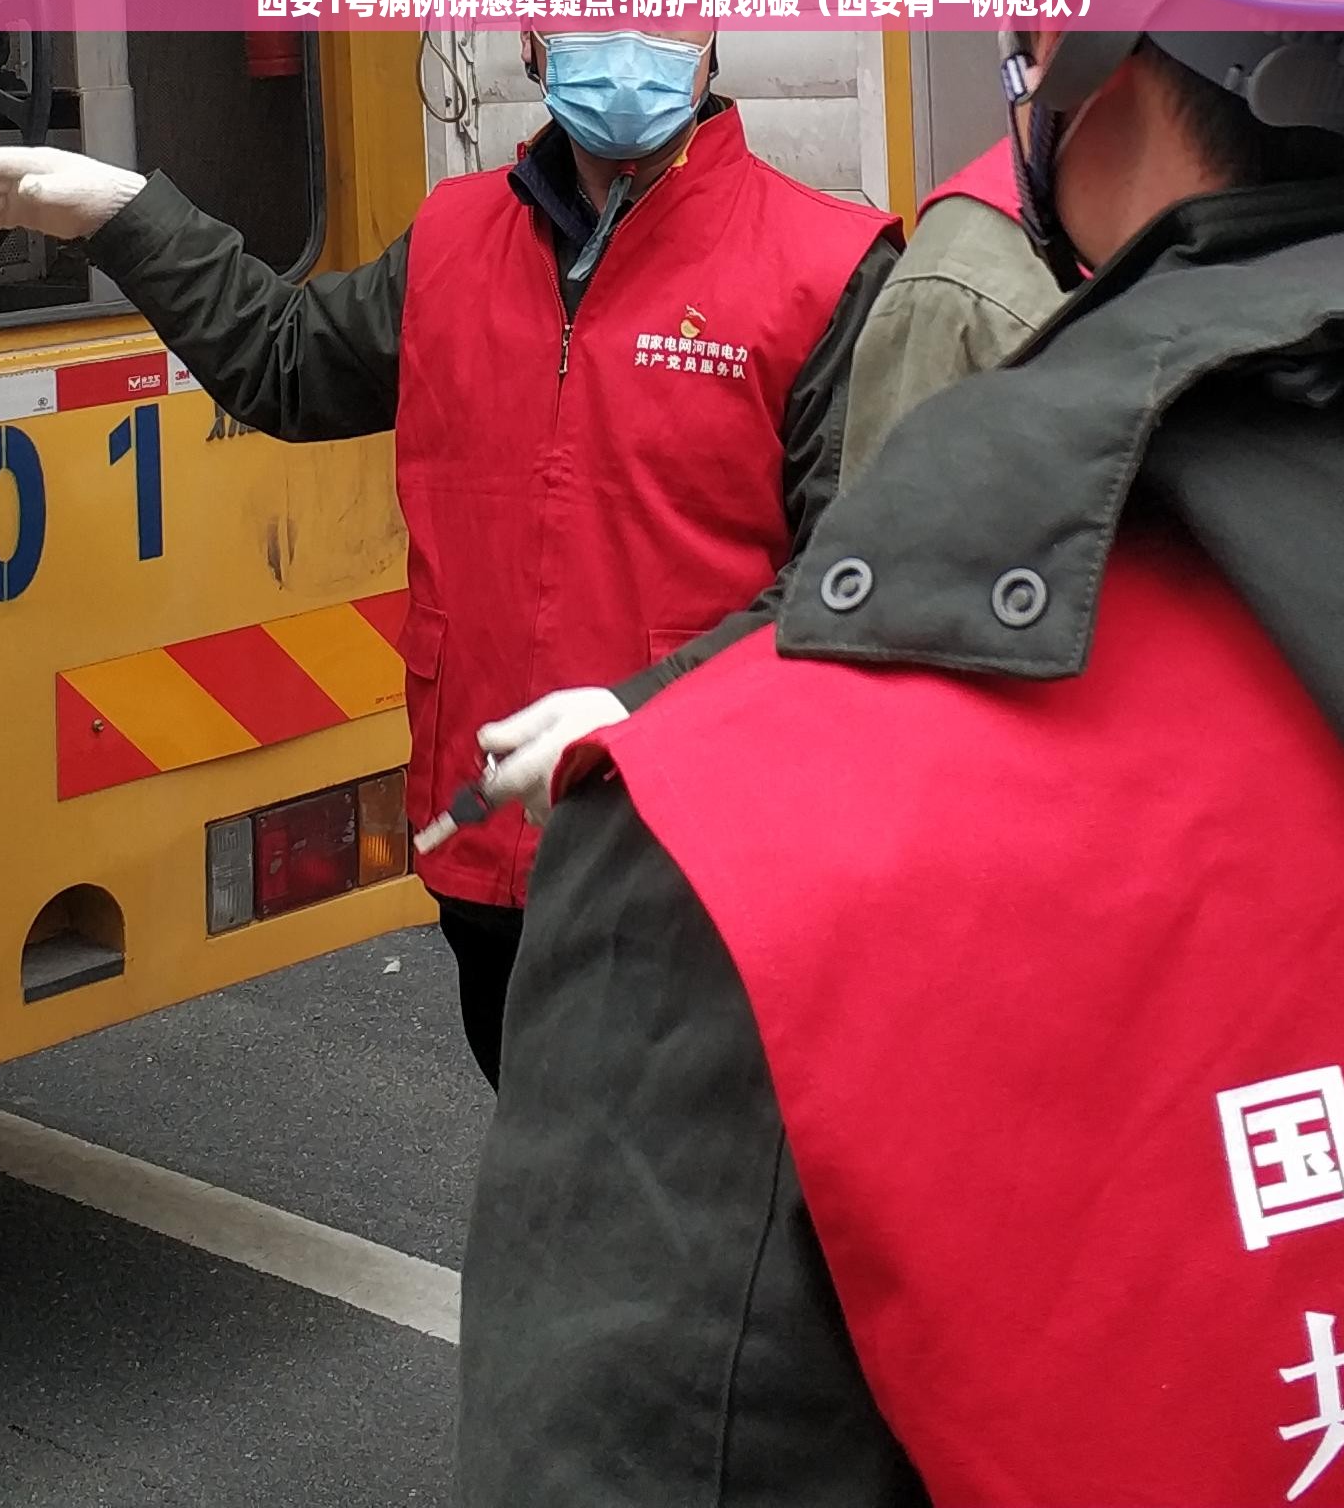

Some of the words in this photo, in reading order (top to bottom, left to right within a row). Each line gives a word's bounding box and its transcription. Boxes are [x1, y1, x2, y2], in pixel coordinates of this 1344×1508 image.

[636, 334, 748, 362] 国家电网河南电力
[634, 351, 746, 379] 共产党员服务队
